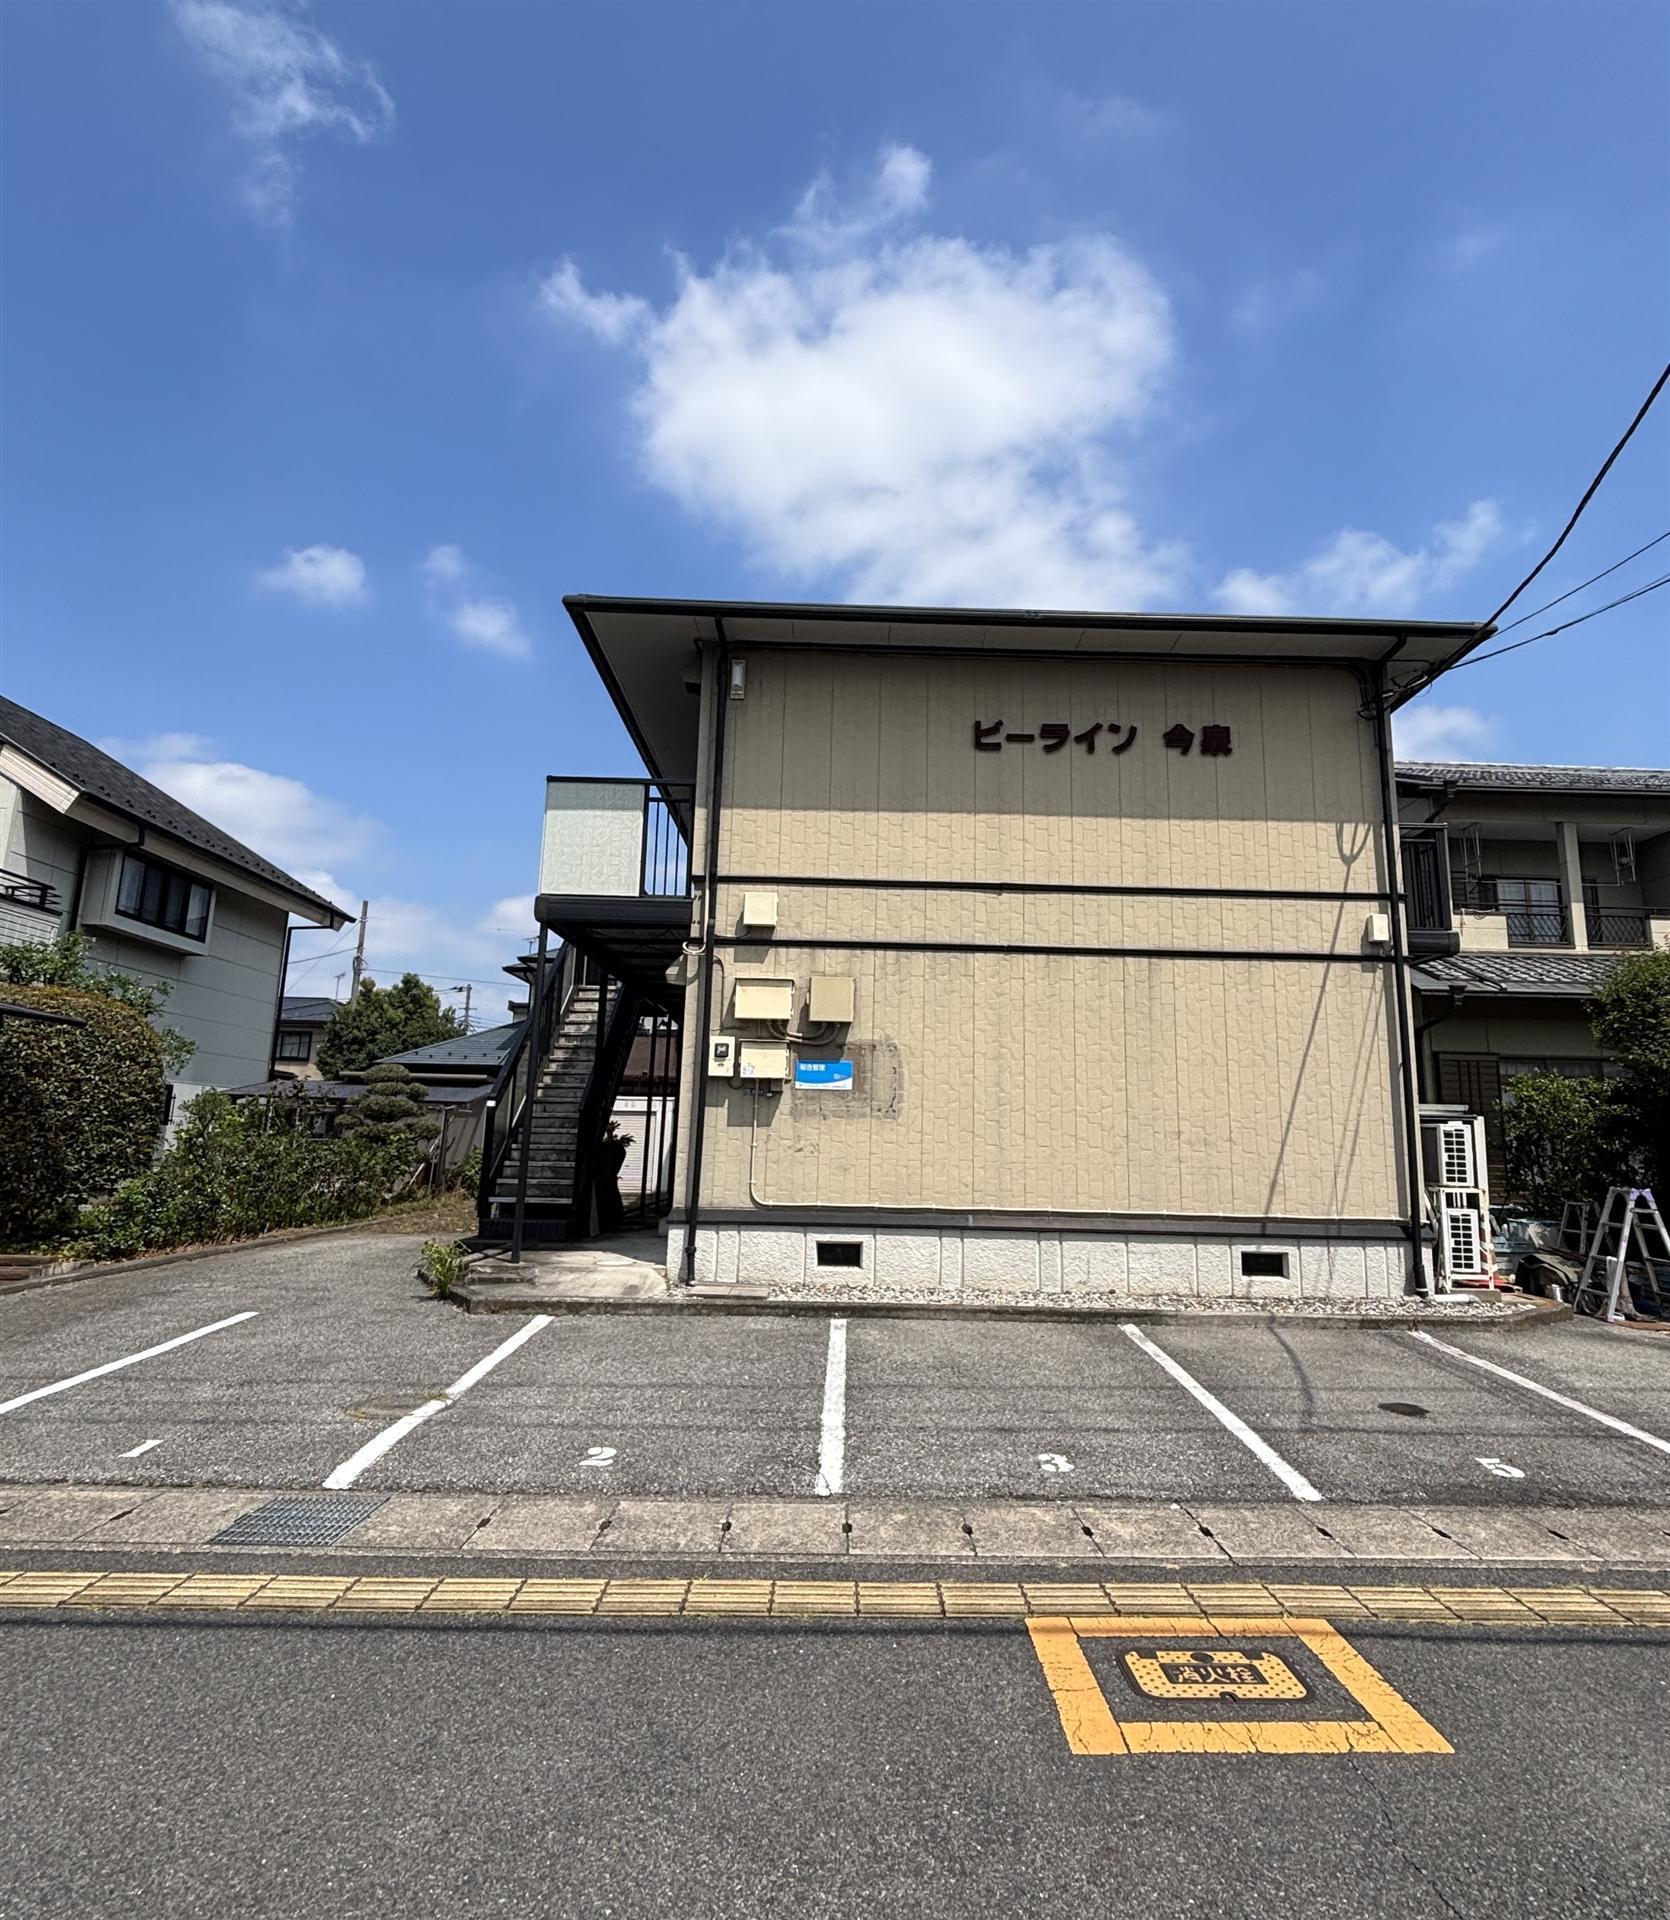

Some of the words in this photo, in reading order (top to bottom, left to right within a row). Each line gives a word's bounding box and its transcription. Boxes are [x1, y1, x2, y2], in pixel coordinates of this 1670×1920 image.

[974, 720, 1138, 754] ビーライン
[1162, 723, 1233, 756] 今泉
[117, 1439, 164, 1458] 1
[579, 1446, 617, 1467] 2
[1038, 1452, 1075, 1472] 3
[1474, 1457, 1526, 1478] 5
[1169, 1665, 1258, 1683] 消火栓
